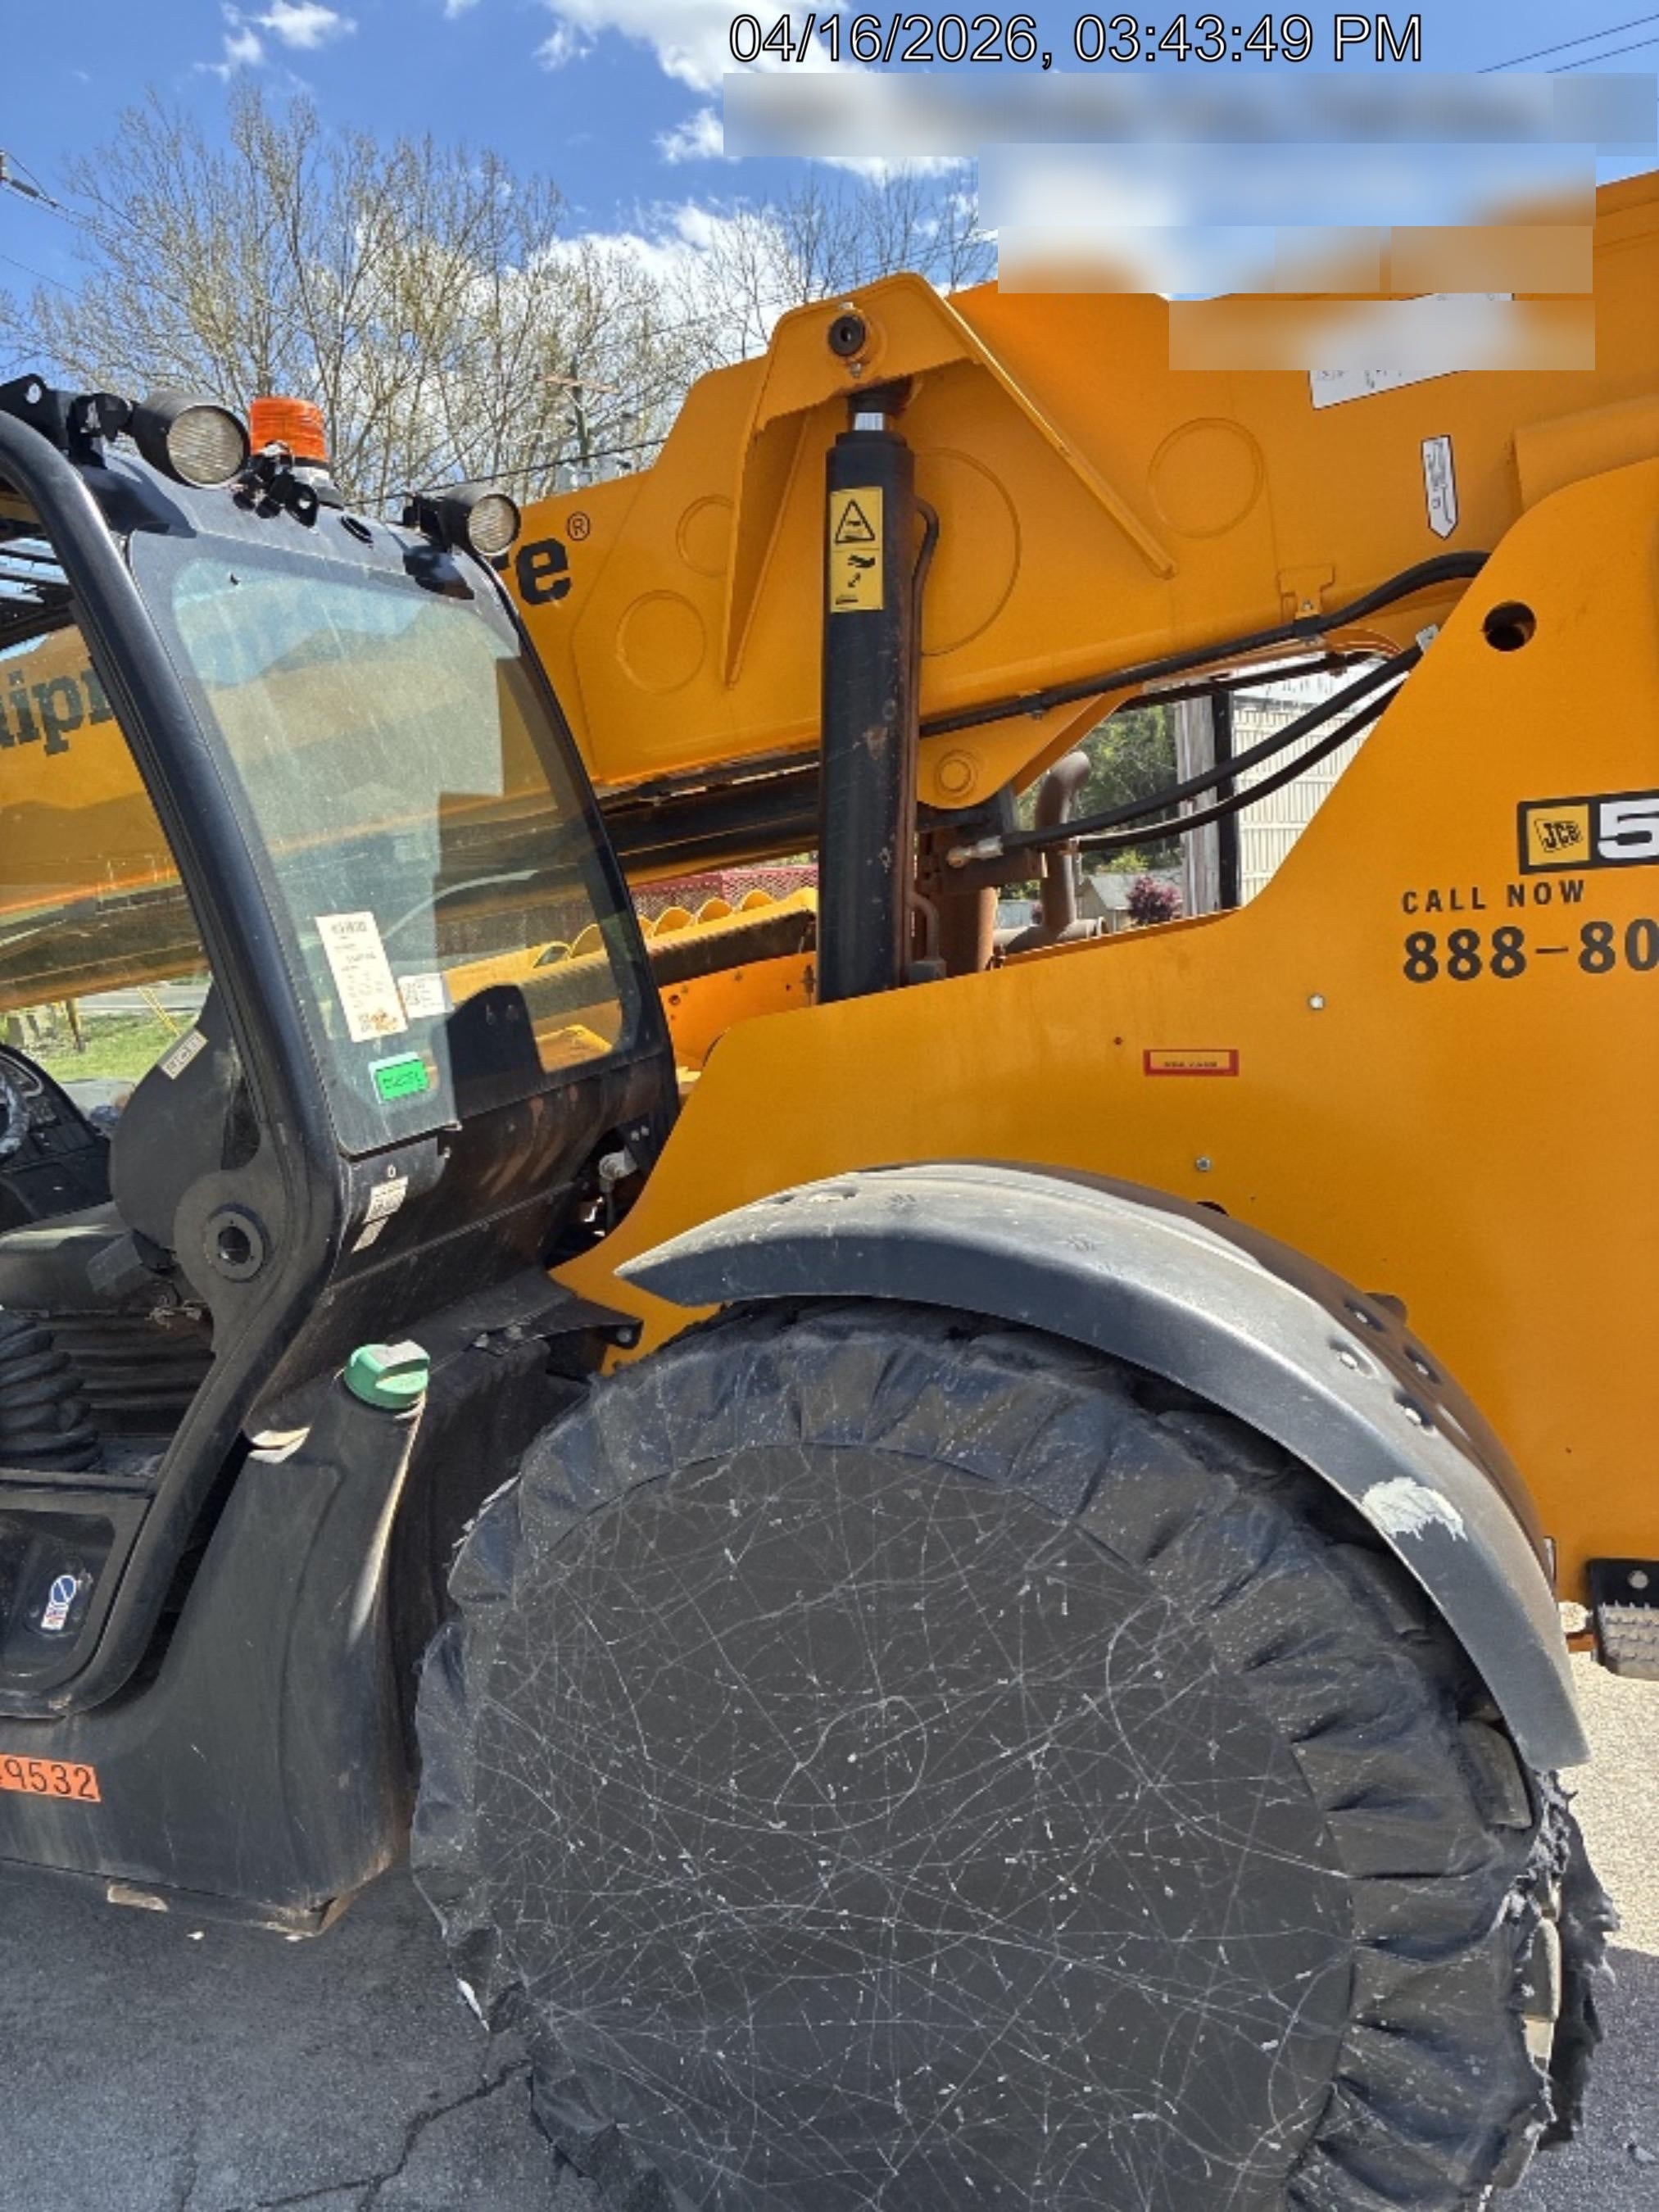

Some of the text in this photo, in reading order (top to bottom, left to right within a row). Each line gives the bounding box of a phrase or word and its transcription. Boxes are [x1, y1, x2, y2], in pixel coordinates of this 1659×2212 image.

[1543, 820, 1583, 850] JCB
[1402, 879, 1584, 914] CALL NOW
[0, 1760, 95, 1799] 9532
